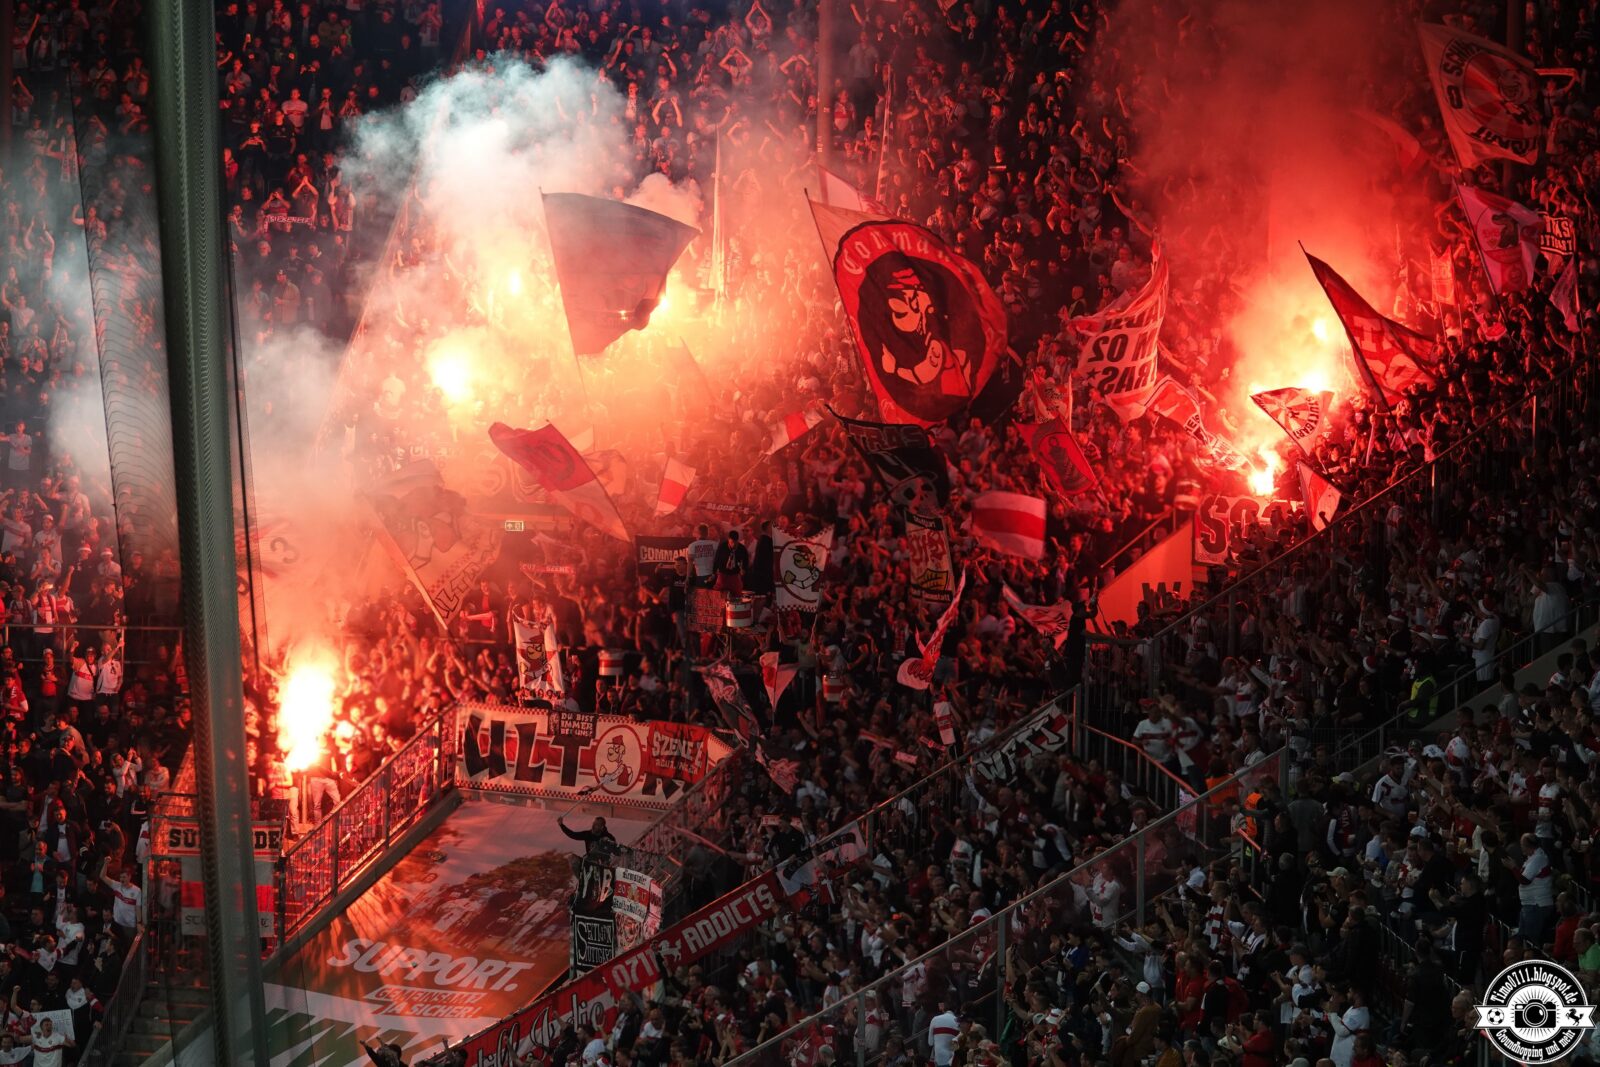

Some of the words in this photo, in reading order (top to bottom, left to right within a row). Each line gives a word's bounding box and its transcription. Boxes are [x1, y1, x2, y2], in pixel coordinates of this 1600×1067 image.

[640, 545, 689, 561] COMMAN
[561, 712, 573, 720] DU
[576, 713, 594, 722] BIST
[561, 720, 593, 731] IMMER
[652, 731, 694, 761] SZENE
[169, 829, 280, 849] SÜDE
[611, 948, 659, 992] 0711
[681, 883, 774, 954] ADDICTS
[326, 938, 535, 992] SUPPORT.
[408, 1002, 482, 1018] SICHER!
